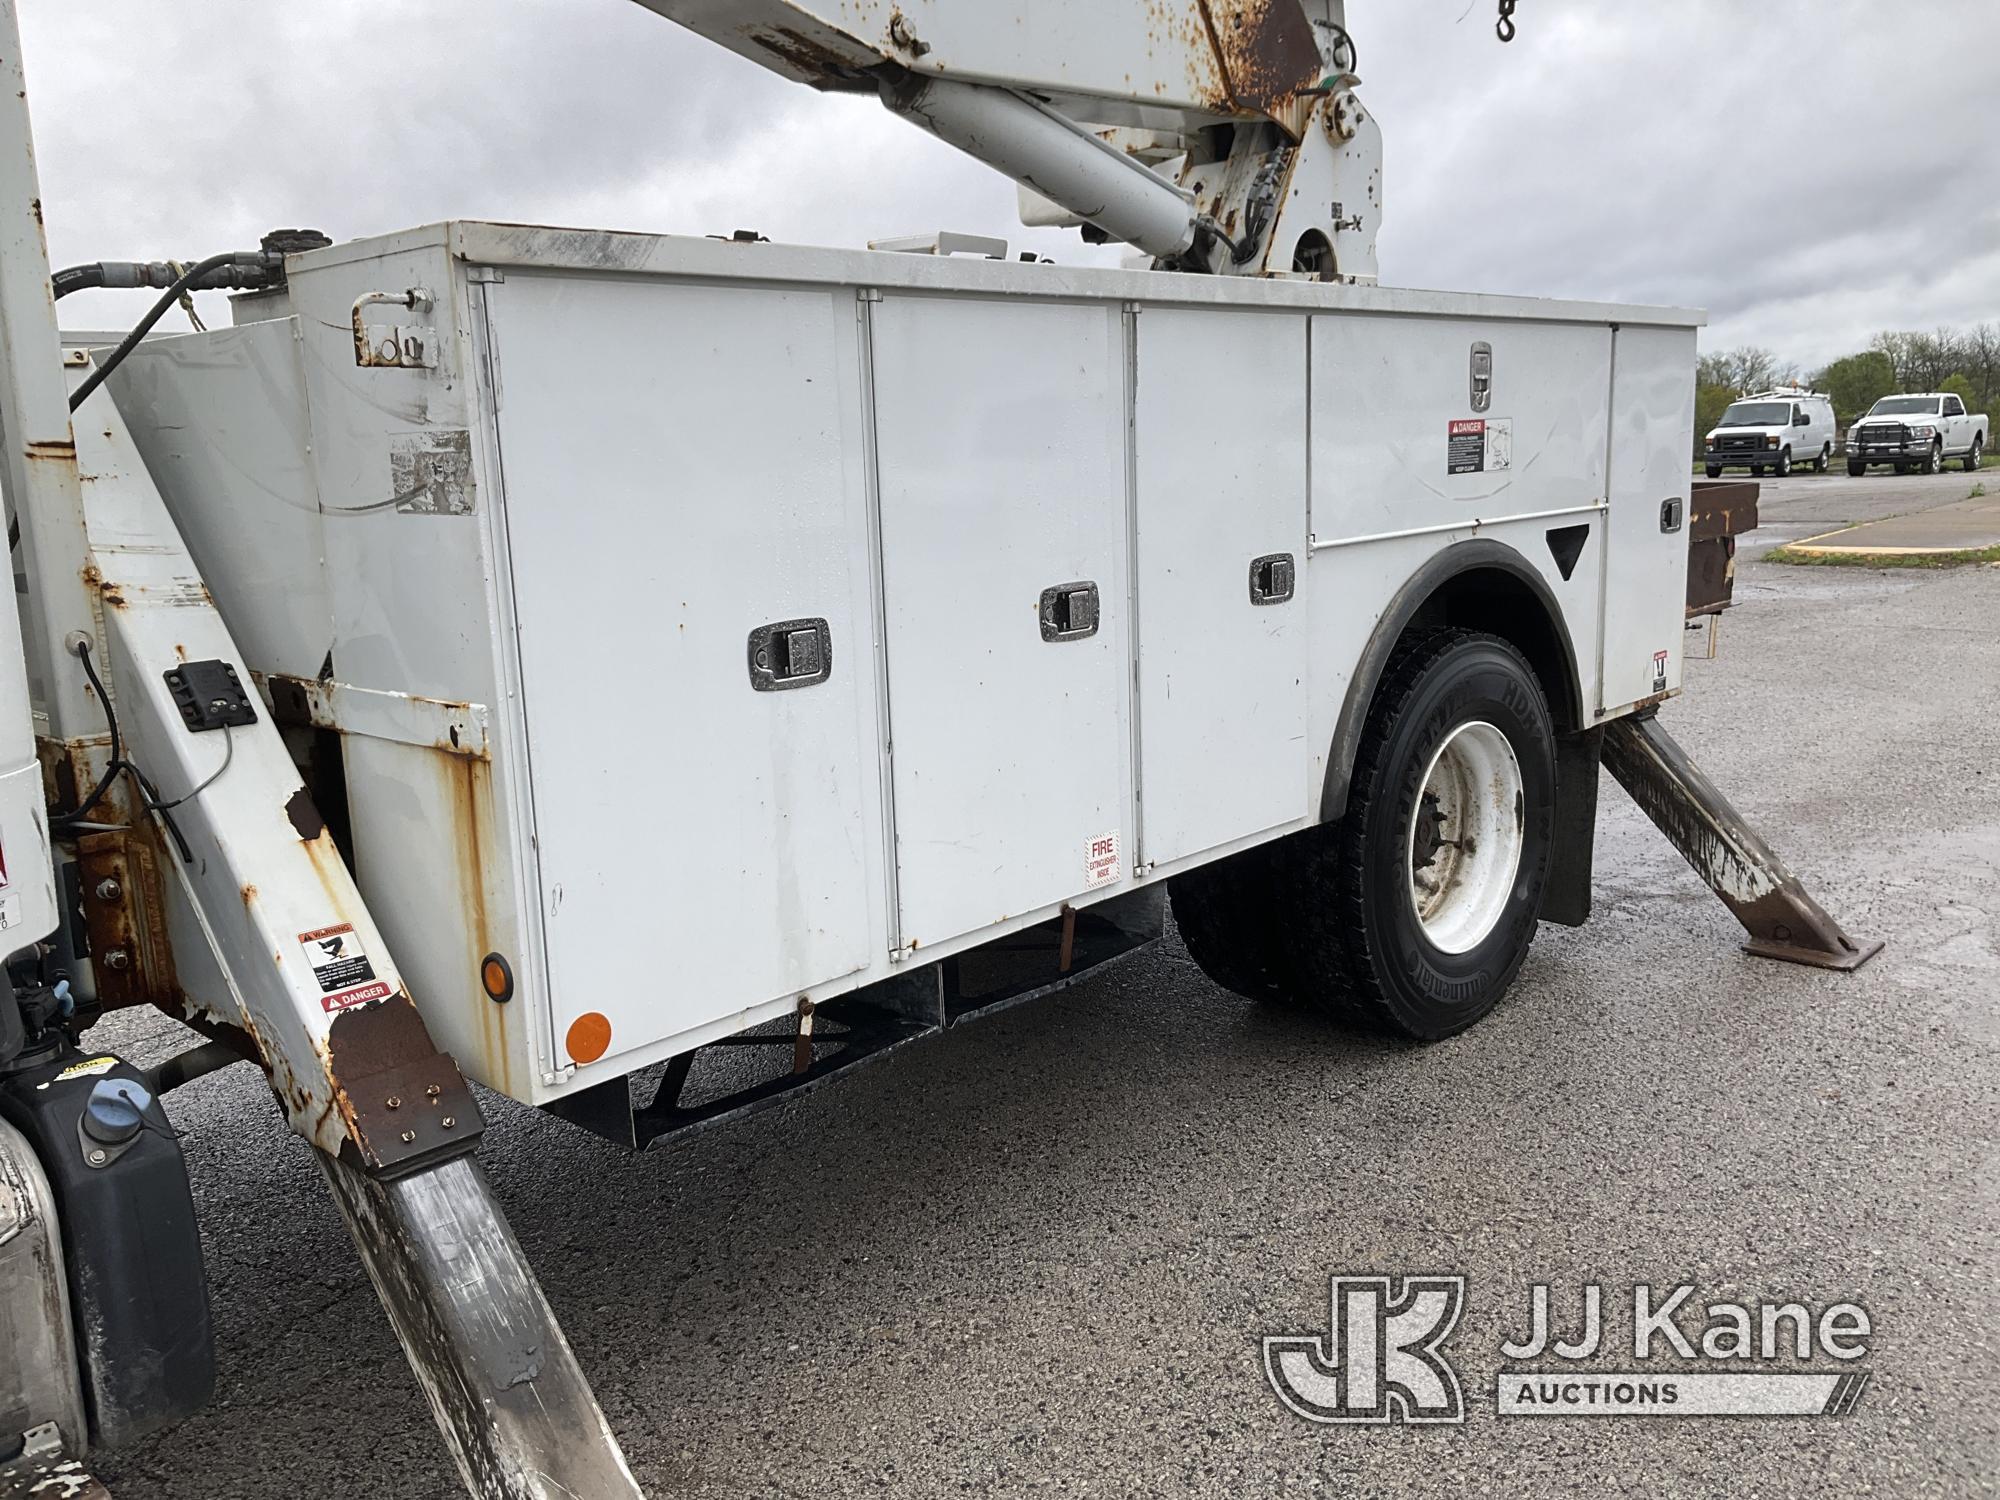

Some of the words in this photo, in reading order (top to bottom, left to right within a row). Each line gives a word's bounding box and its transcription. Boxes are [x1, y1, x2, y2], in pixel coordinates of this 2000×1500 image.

[1458, 421, 1482, 433] DANGER
[1092, 837, 1114, 858] FIRE
[1089, 854, 1117, 871] EXTINGUISHER
[1097, 867, 1110, 879] INSIDE
[313, 923, 350, 938] WARNING
[341, 985, 385, 1005] DANGER
